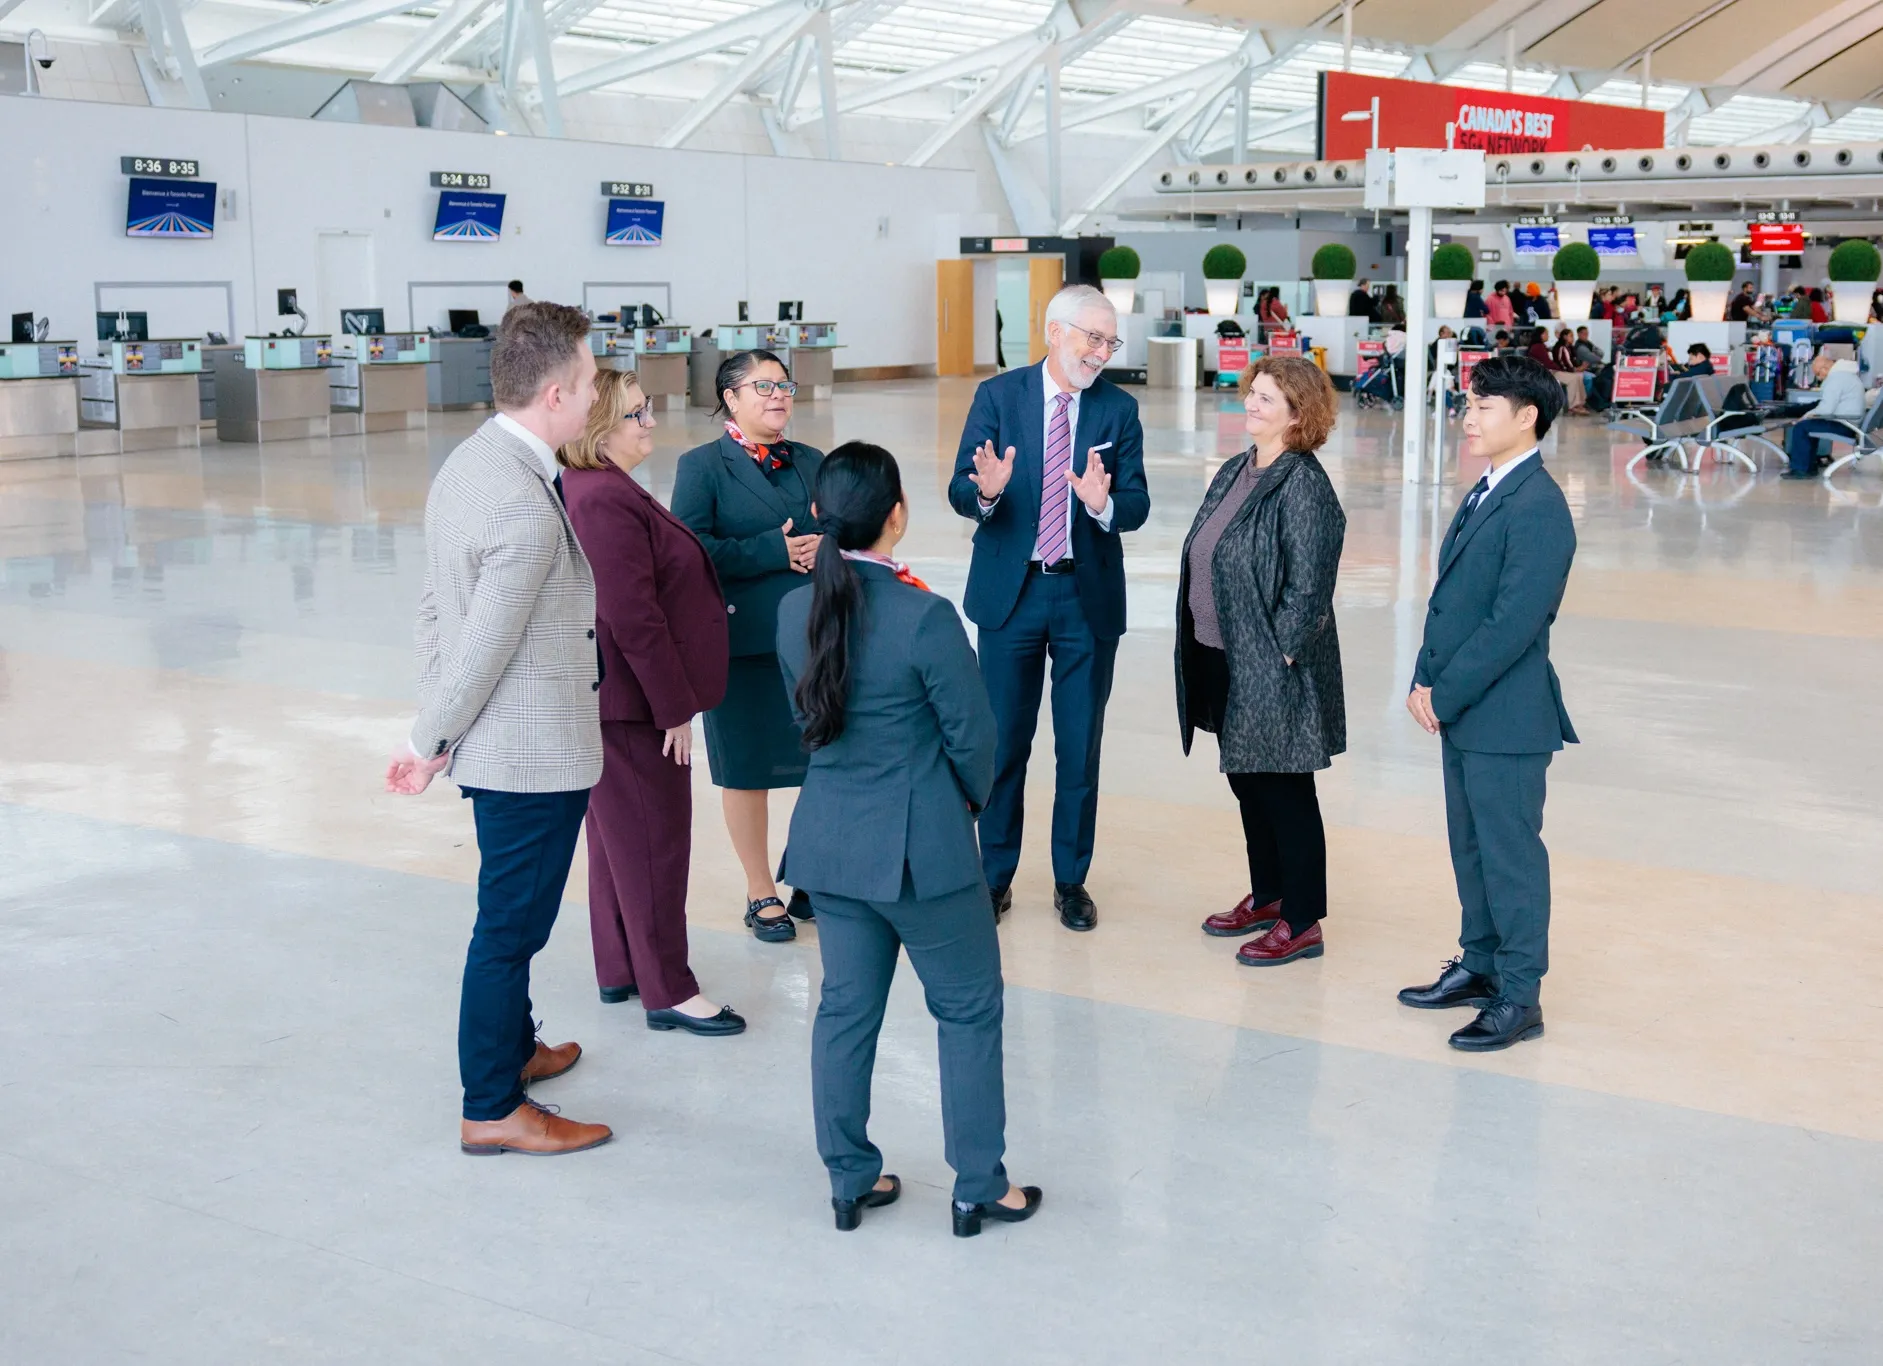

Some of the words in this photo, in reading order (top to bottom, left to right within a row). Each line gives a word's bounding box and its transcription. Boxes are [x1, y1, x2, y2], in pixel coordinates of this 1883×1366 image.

[1459, 104, 1523, 136] CANADA'S
[1524, 112, 1554, 138] BEST
[134, 159, 162, 173] 8-36
[169, 161, 196, 175] 8-35
